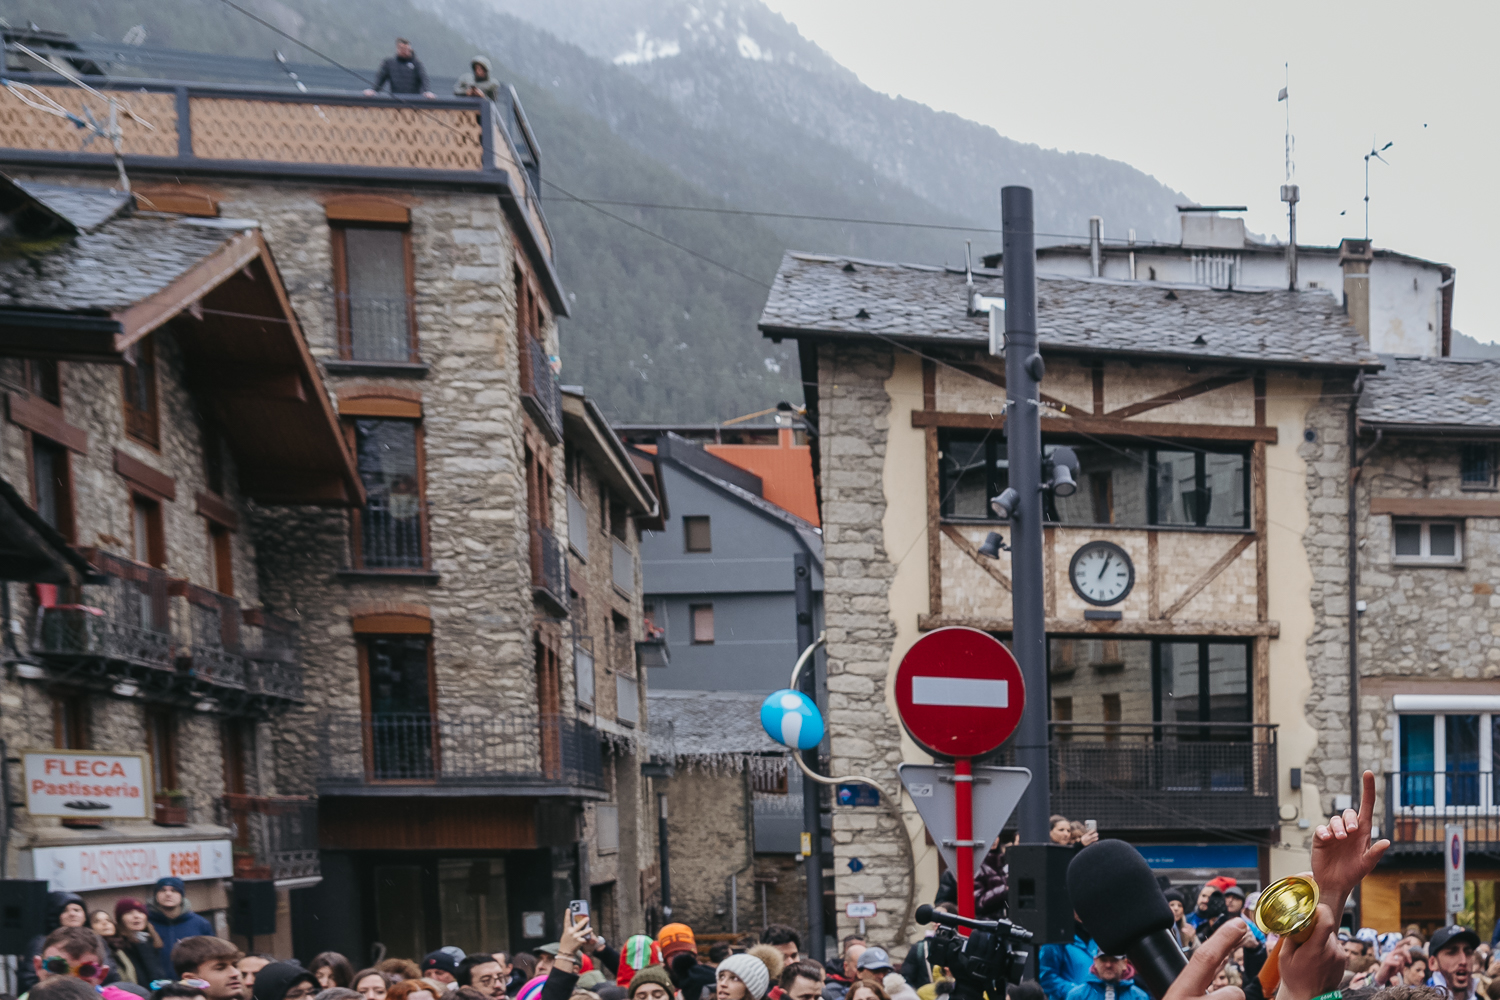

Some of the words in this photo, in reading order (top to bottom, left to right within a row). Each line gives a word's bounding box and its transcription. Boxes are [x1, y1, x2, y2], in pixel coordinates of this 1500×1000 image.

[44, 758, 126, 778] FLECA
[31, 779, 141, 799] Pastisseria
[80, 848, 160, 885] PASTISSERIA
